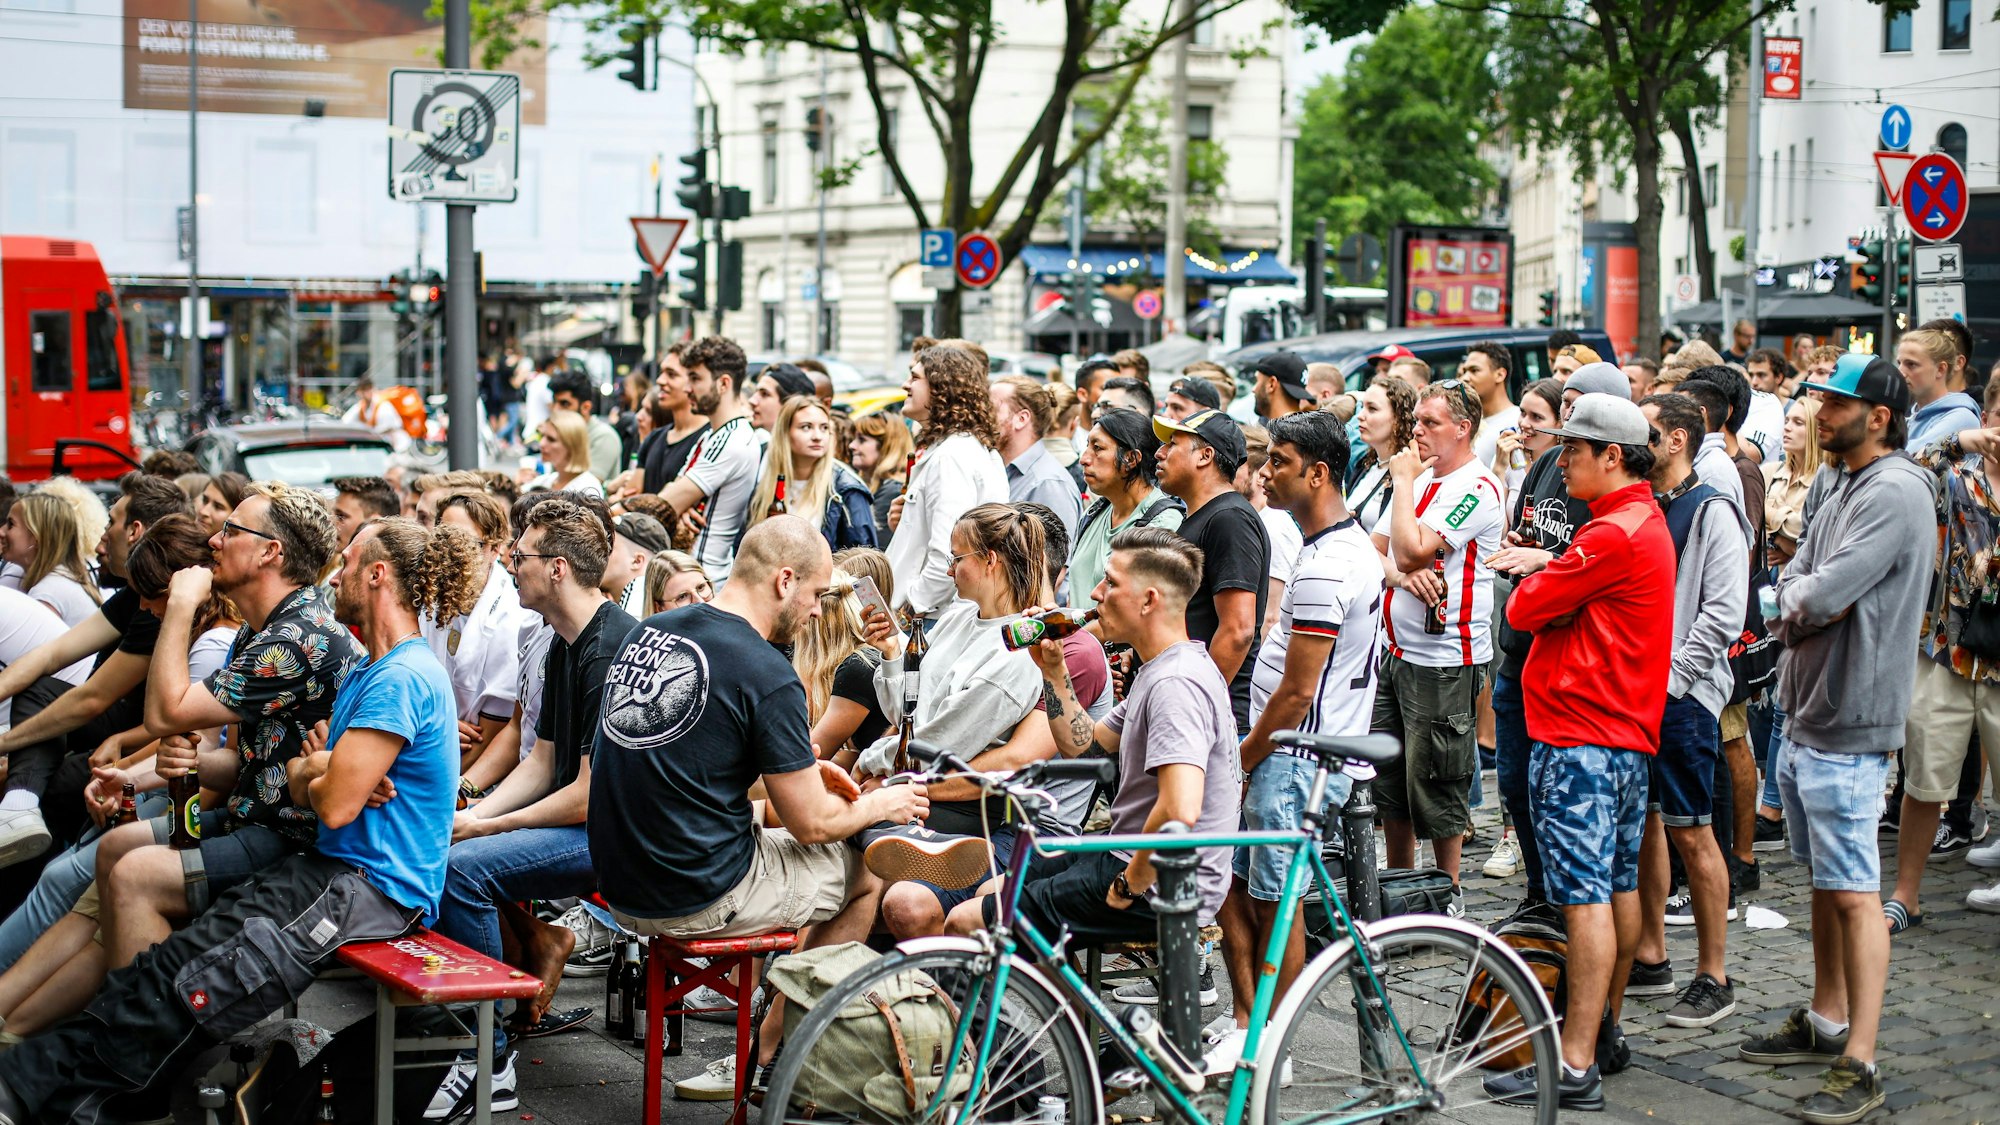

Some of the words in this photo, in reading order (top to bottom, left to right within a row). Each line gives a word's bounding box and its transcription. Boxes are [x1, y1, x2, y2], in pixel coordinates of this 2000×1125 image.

[138, 36, 183, 54] FORD
[1766, 40, 1800, 55] REWE
[924, 234, 943, 263] P
[1450, 497, 1476, 526] DEVK
[638, 626, 682, 652] THE
[620, 643, 669, 669] IRON
[605, 663, 655, 690] DEATH
